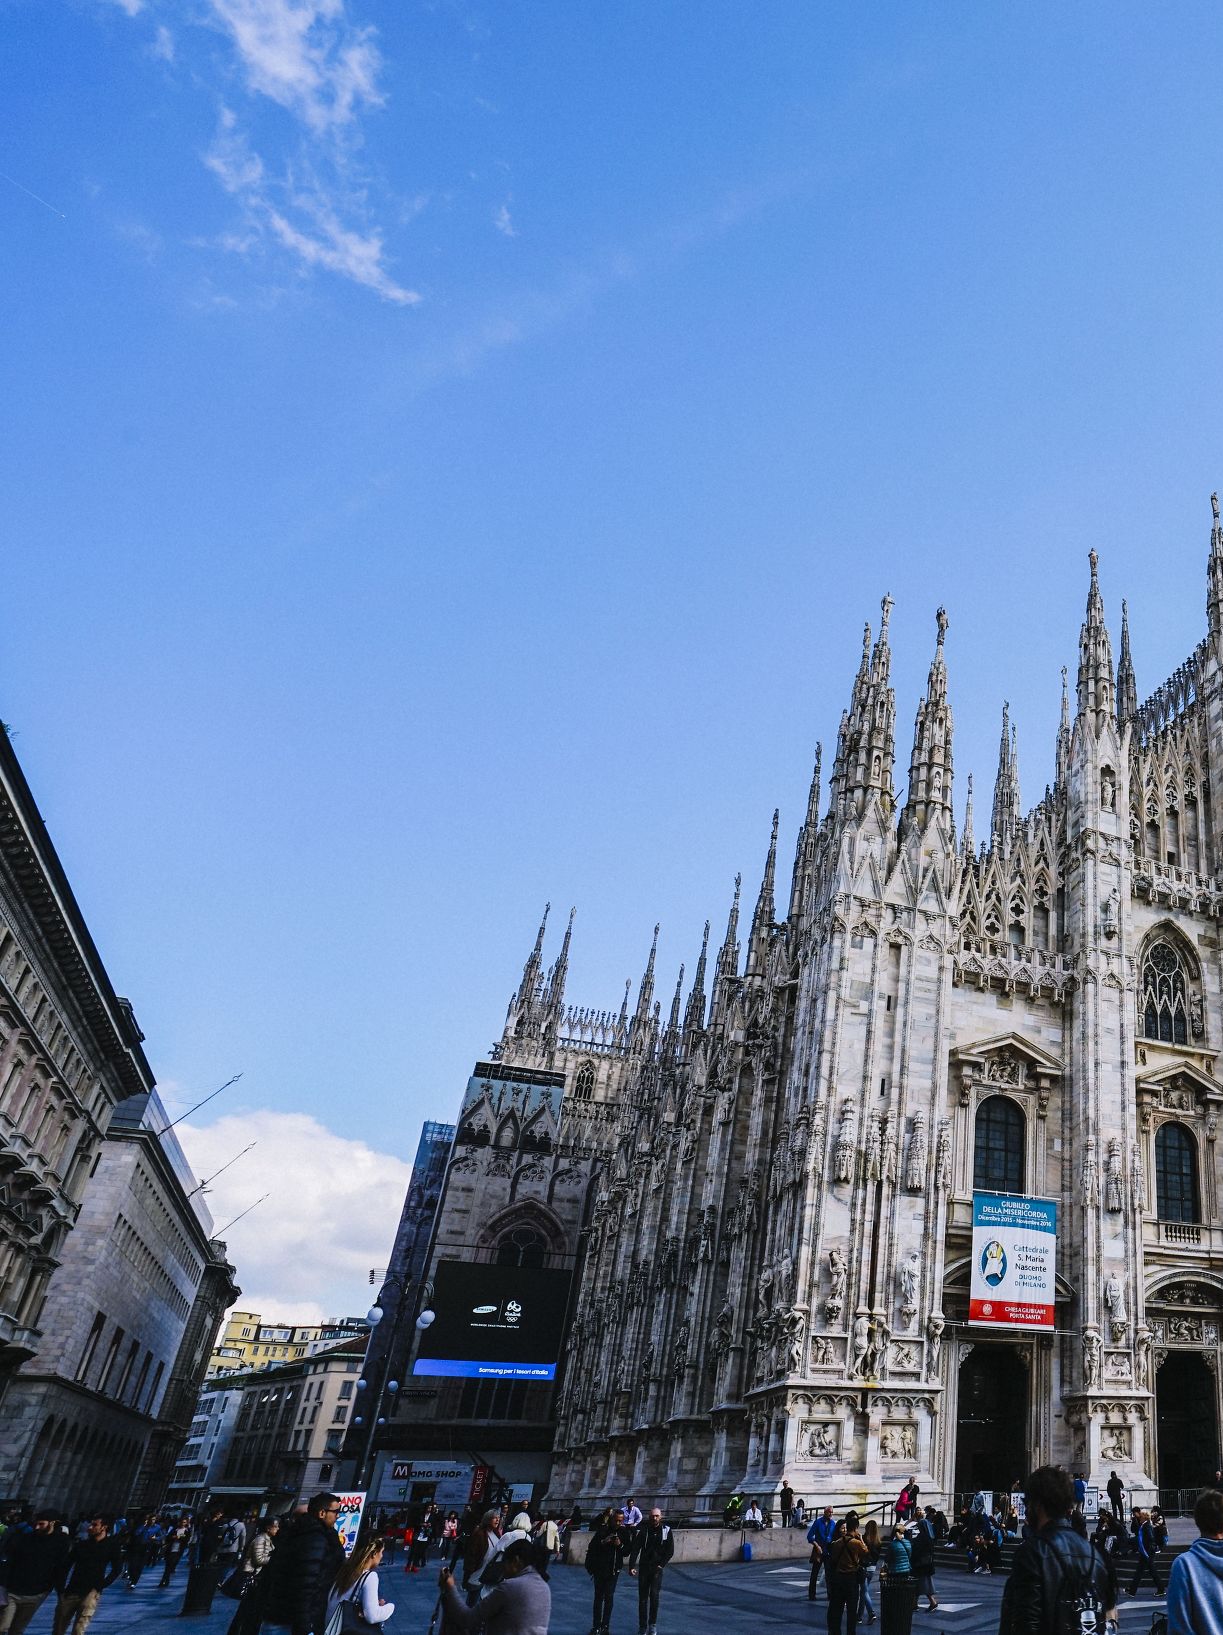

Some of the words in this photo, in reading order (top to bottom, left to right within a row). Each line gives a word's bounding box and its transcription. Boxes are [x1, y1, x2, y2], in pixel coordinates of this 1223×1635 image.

[1001, 1200, 1030, 1210] GIUBILEO
[982, 1206, 1002, 1214] DELLA
[1003, 1208, 1048, 1218] MISERICORDIA
[1016, 1218, 1040, 1226] Novembre
[1014, 1244, 1048, 1254] Cattedrale
[1018, 1254, 1024, 1262] S.
[1014, 1262, 1046, 1272] Nascente
[394, 1465, 408, 1476] M
[472, 1469, 484, 1496] TICKET
[340, 1496, 362, 1506] ANO
